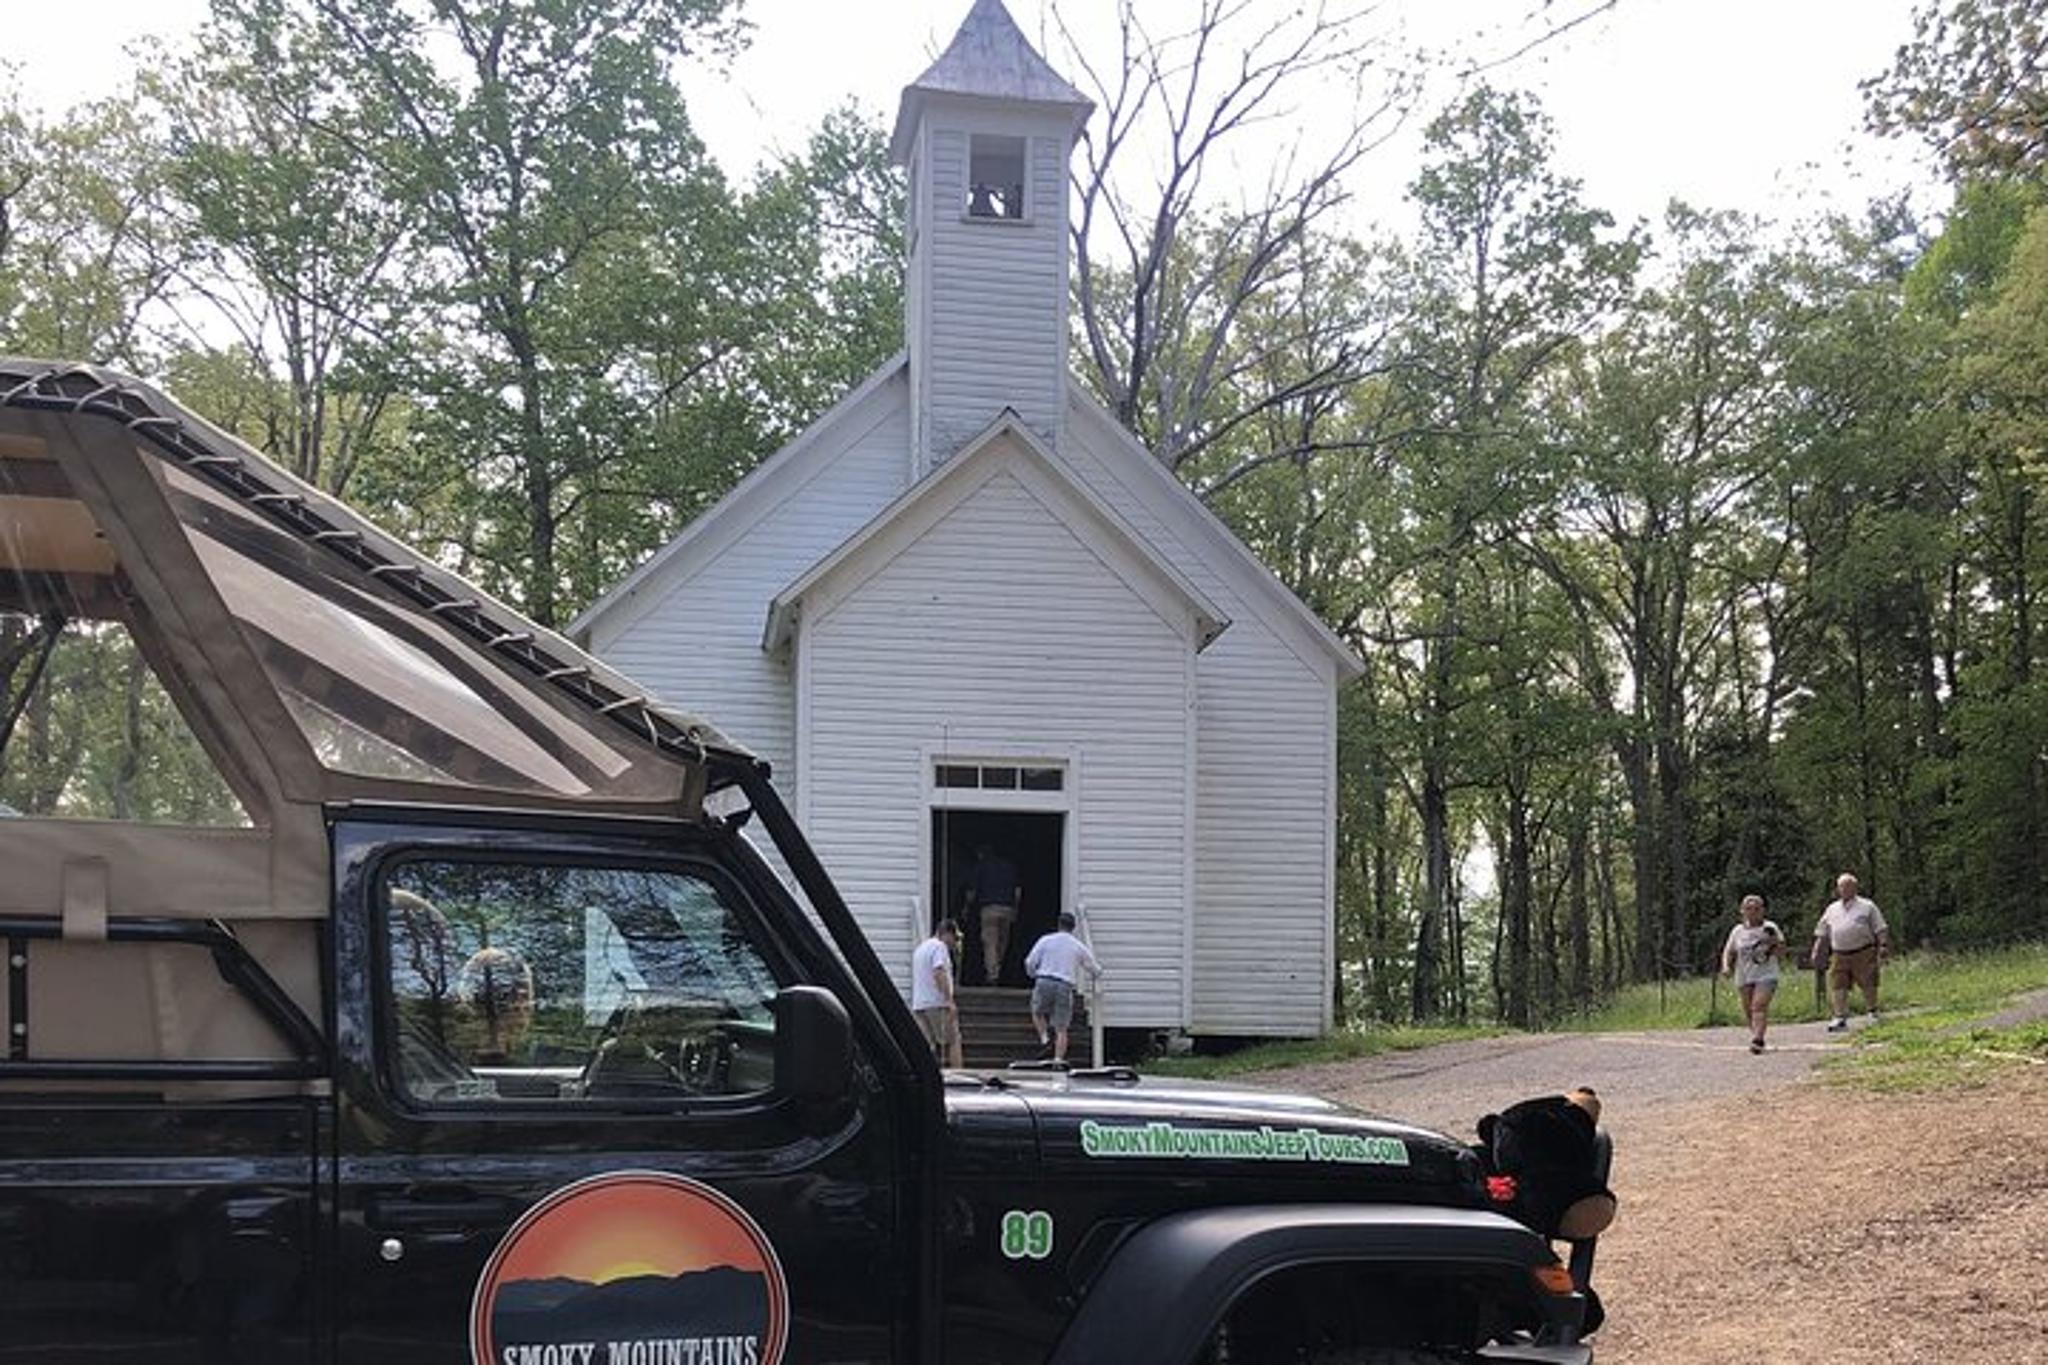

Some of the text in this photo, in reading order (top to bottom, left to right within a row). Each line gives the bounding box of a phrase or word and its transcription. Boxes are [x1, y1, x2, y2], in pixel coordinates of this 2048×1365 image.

[1002, 1211, 1053, 1258] 89
[503, 1336, 758, 1365] SMOKY MOUNTAINS
